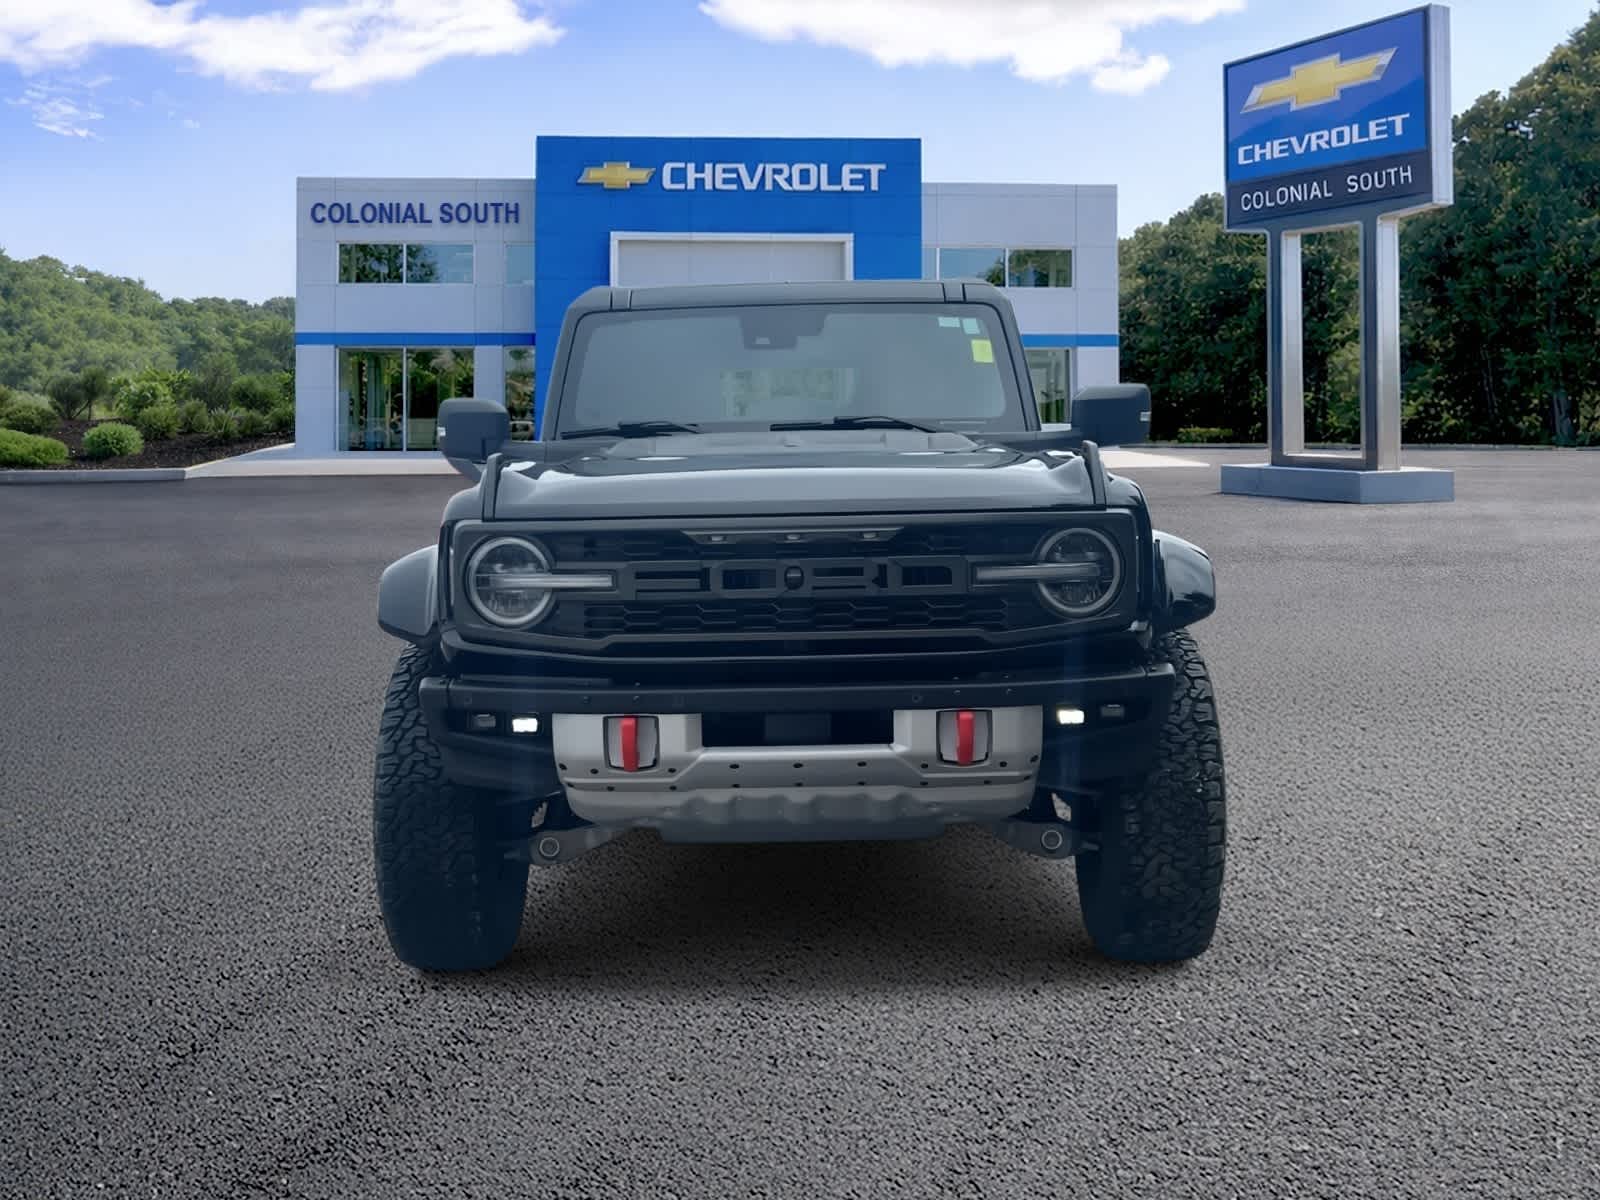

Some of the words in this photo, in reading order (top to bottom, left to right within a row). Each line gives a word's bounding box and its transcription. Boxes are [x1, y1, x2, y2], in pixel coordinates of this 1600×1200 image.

[1237, 113, 1410, 165] CHEVROLET
[661, 162, 887, 192] CHEVROLET
[1240, 180, 1333, 211] COLONIAL
[1346, 165, 1413, 194] SOUTH
[310, 202, 433, 224] COLONIAL
[438, 202, 521, 224] SOUTH
